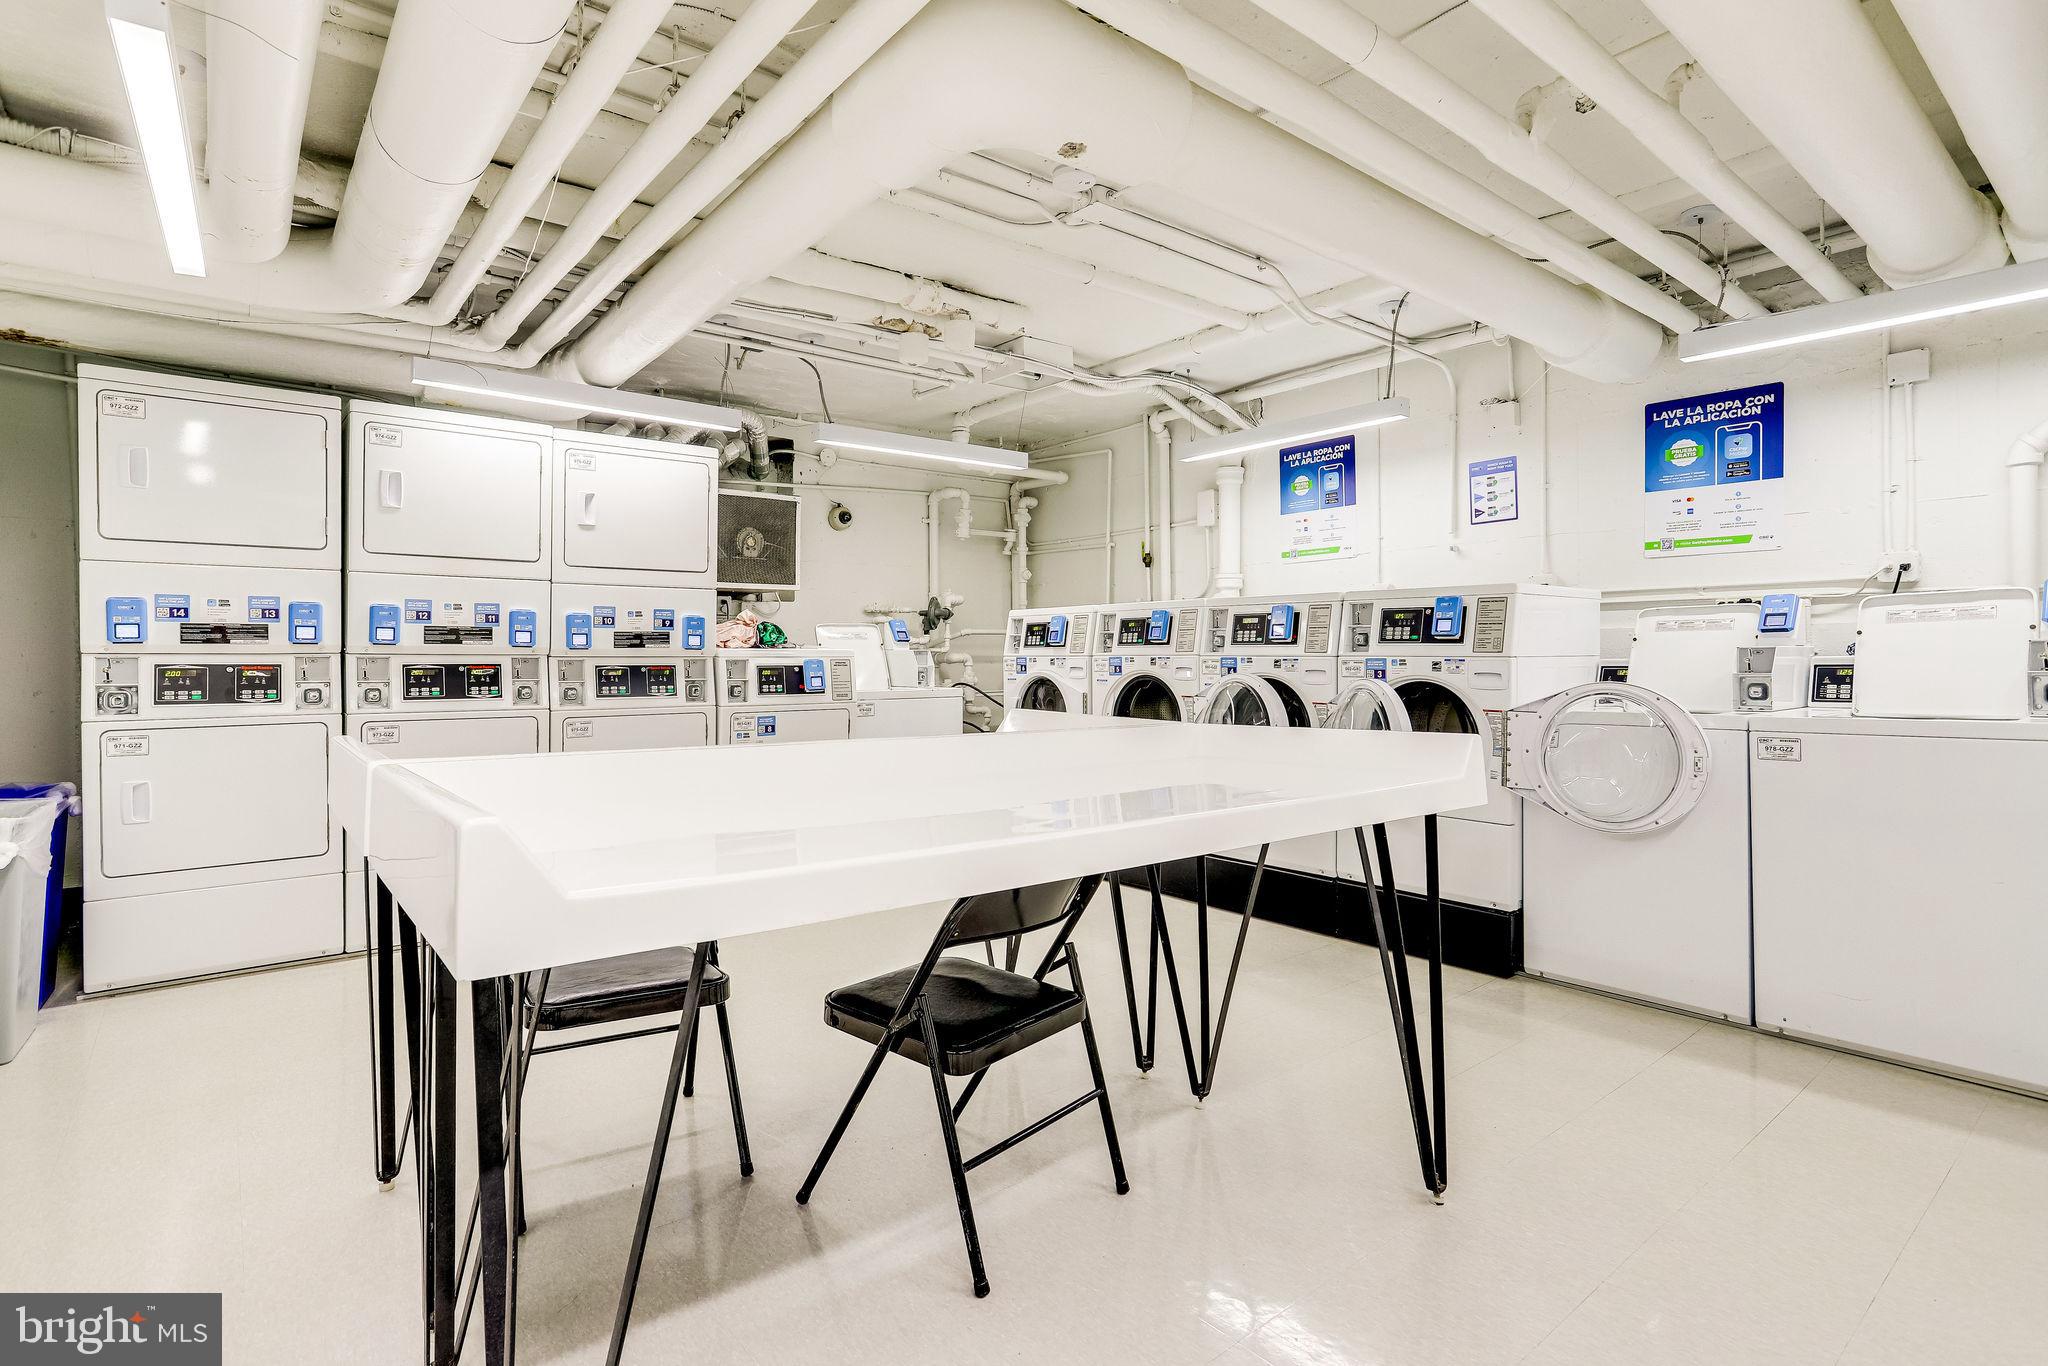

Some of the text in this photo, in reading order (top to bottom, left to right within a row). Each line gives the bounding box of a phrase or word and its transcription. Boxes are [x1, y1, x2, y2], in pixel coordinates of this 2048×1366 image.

[1653, 394, 1775, 422] LAVE LA ROPA CON
[1664, 406, 1761, 429] LA APLICACIÓN
[1284, 443, 1350, 462] LAVE LA ROPA CON
[1290, 452, 1343, 467] LA APLICACIÓN
[172, 609, 185, 617] 14
[265, 610, 276, 618] 13
[1377, 670, 1382, 678] 3
